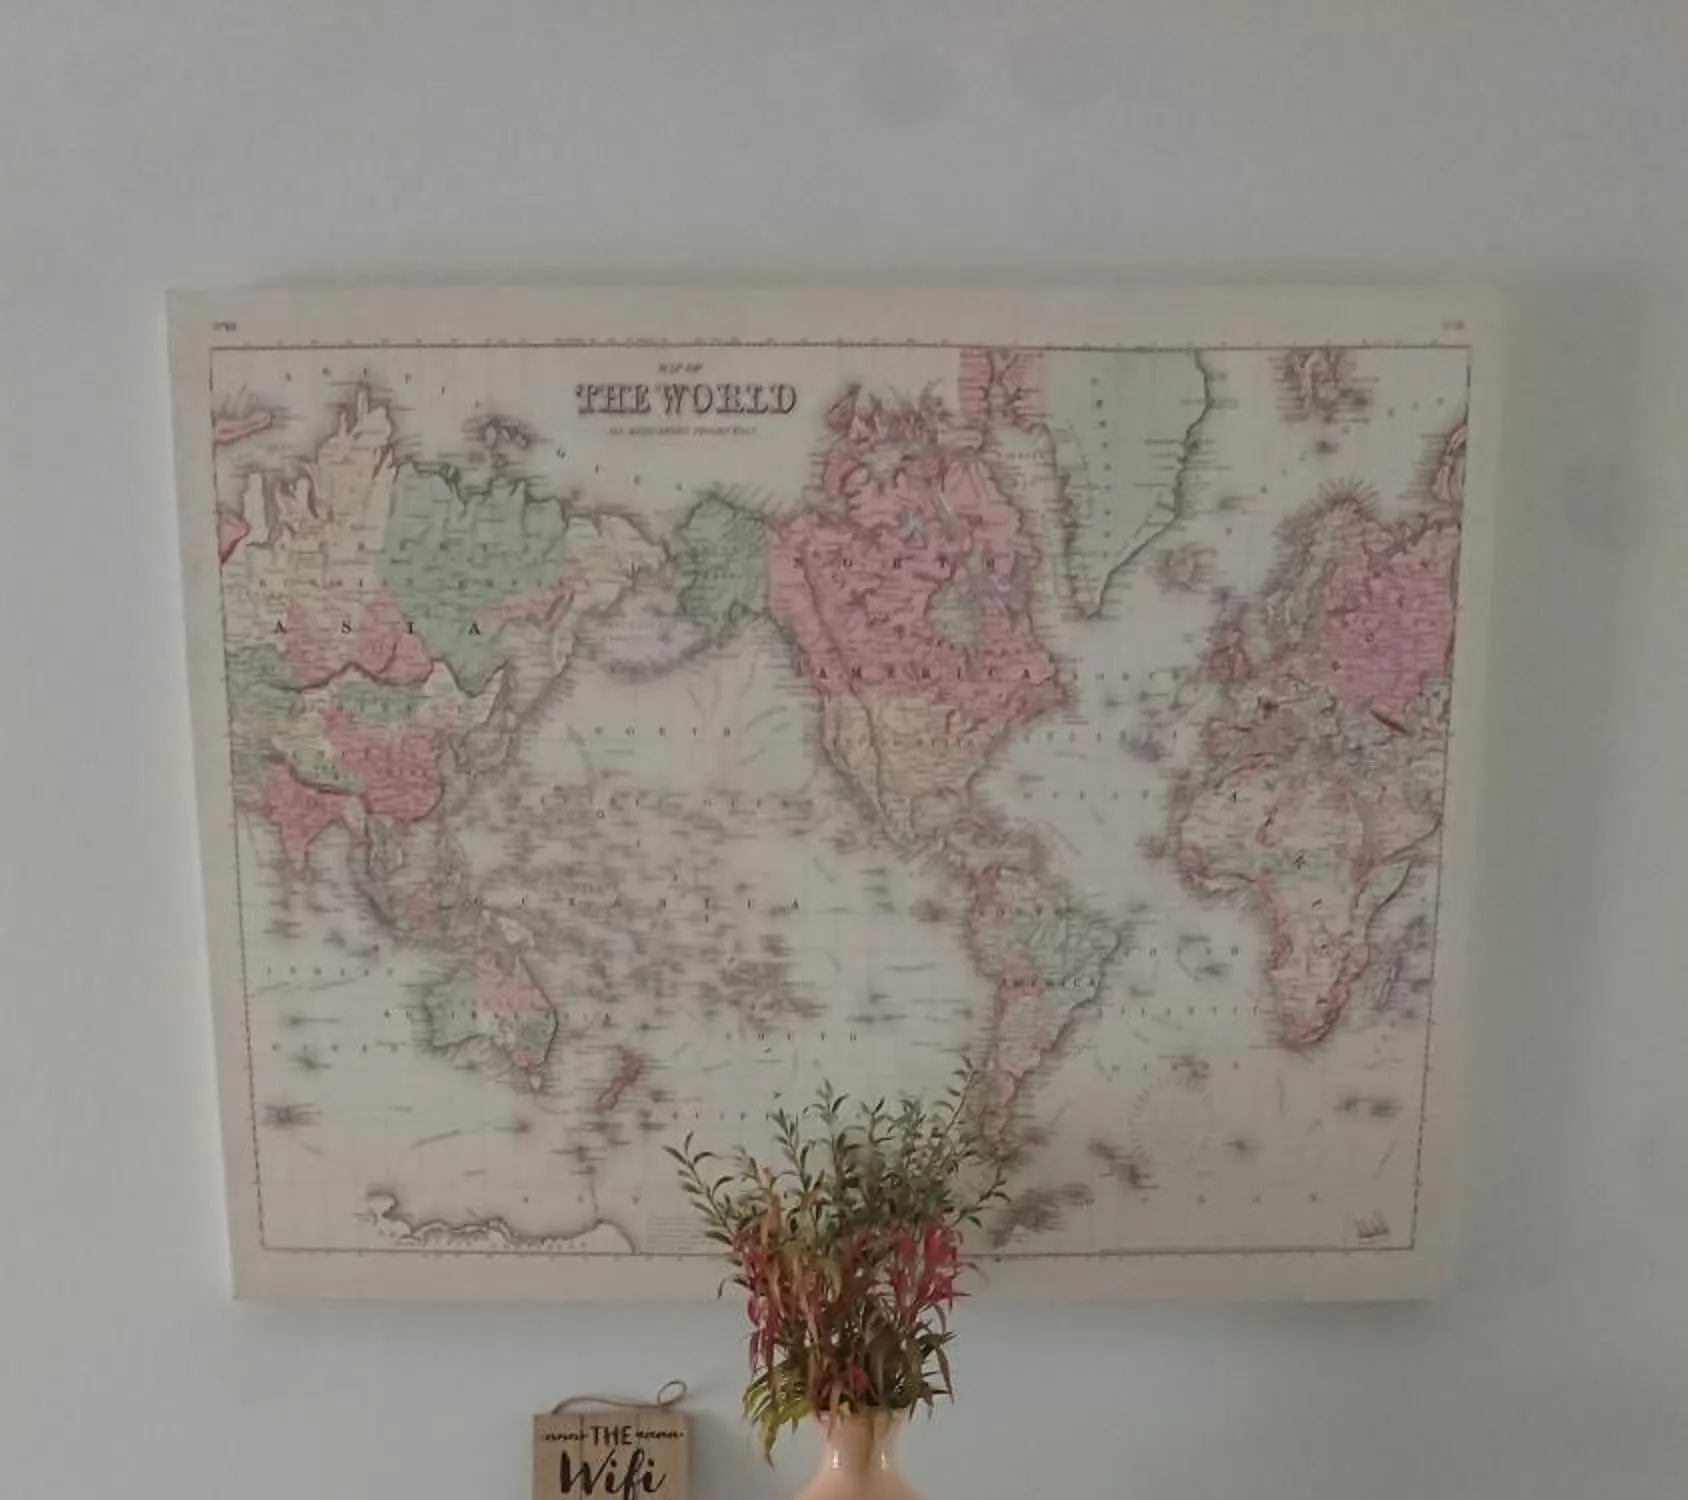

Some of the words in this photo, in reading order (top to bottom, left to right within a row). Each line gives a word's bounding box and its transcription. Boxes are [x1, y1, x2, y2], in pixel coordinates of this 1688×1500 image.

[576, 383, 651, 415] THE
[655, 383, 798, 415] WORLD
[591, 1426, 634, 1445] THE
